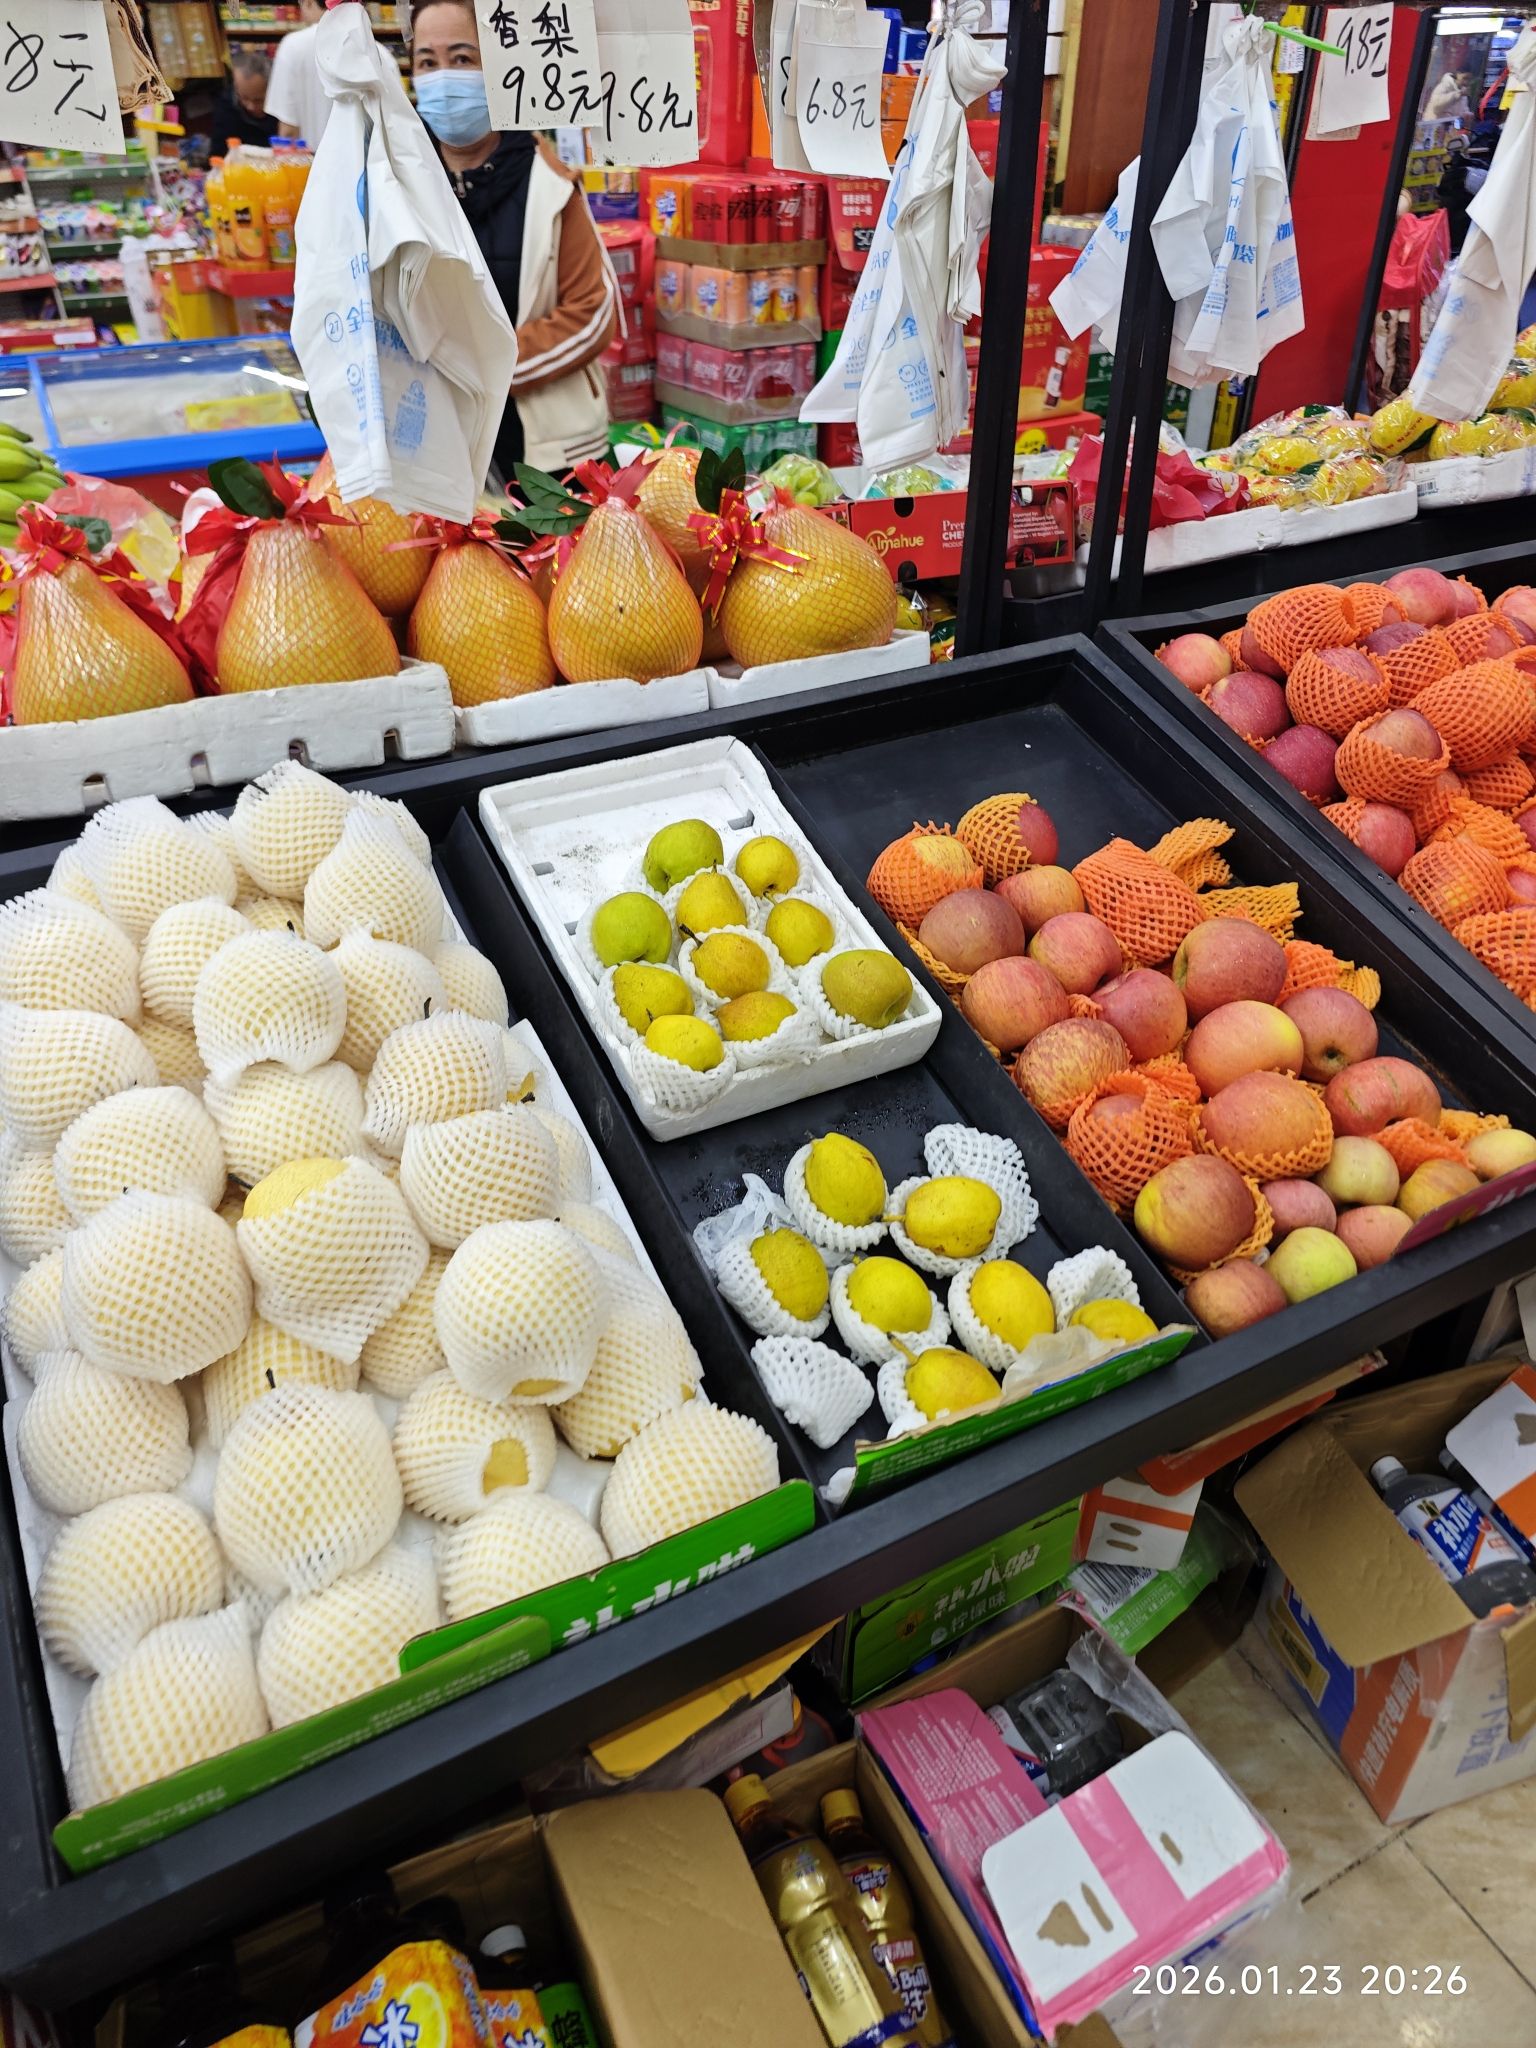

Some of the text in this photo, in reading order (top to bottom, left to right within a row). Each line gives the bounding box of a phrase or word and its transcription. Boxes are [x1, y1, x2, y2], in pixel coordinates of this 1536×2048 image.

[489, 2, 579, 58] 香梨
[1336, 16, 1390, 77] 9.8元
[5, 21, 107, 122] 8元
[502, 63, 602, 124] 9.8元
[601, 71, 693, 142] 9.8元
[806, 77, 875, 130] 6.8元
[867, 532, 924, 550] Almahue
[934, 1543, 1041, 1621] 补水啦
[951, 1591, 1007, 1634] 柠檬味
[900, 1966, 929, 1991] Bull
